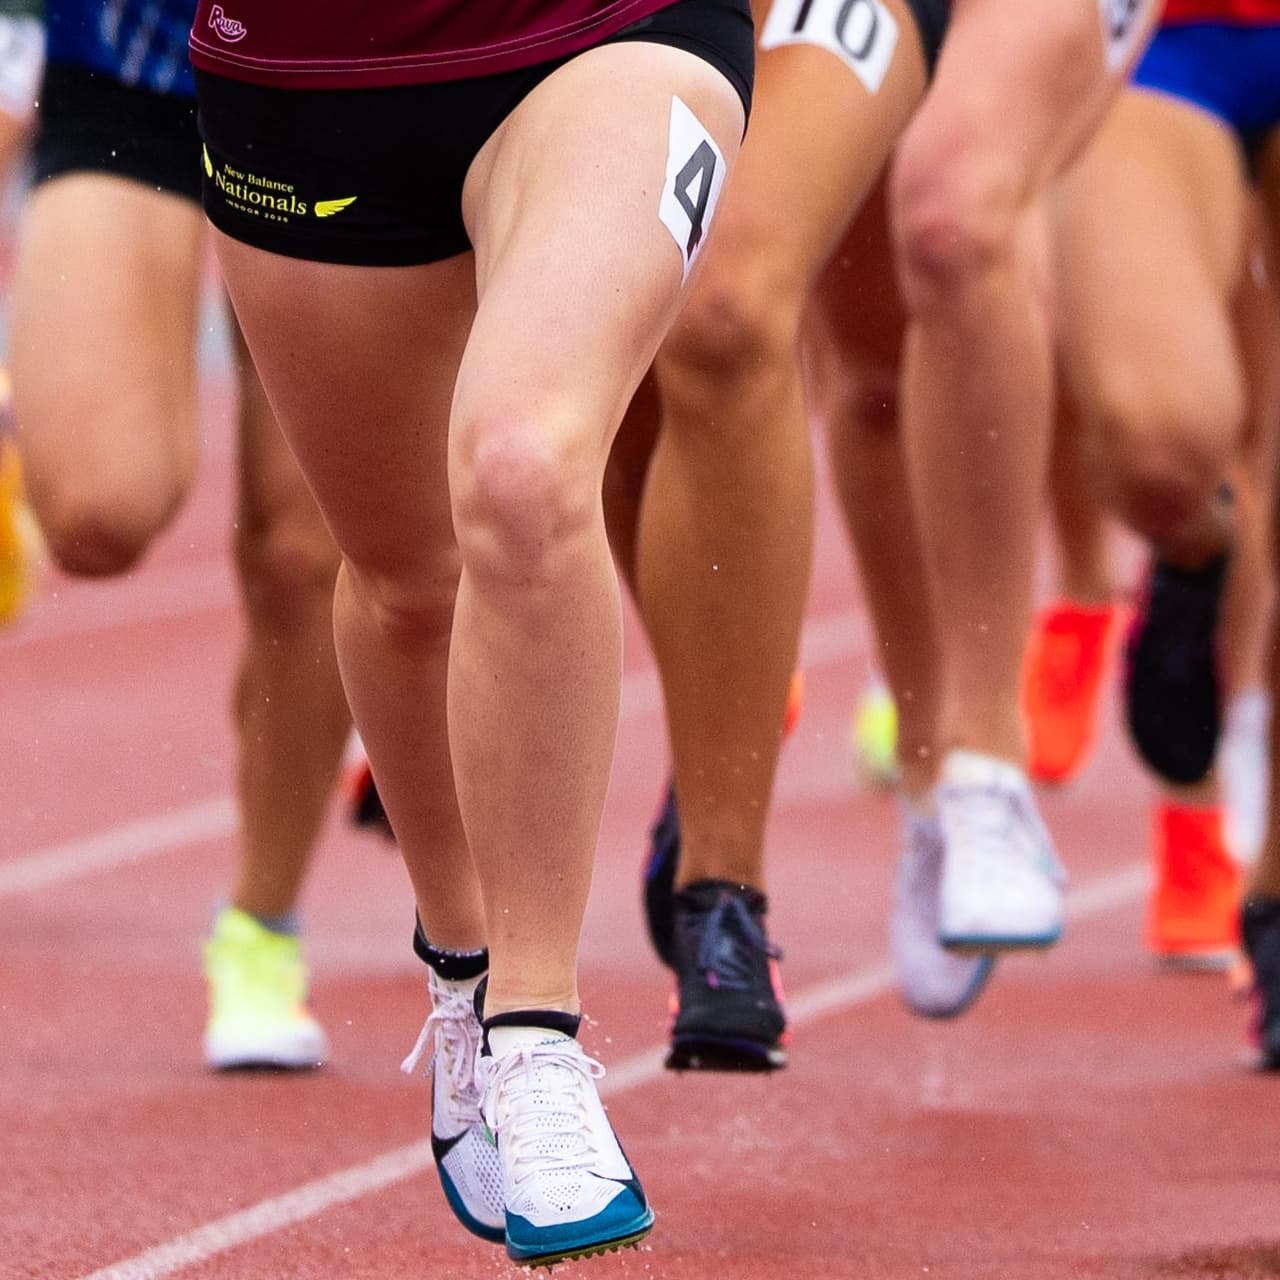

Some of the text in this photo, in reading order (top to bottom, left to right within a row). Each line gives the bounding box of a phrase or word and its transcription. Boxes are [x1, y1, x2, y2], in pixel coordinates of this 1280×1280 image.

[215, 170, 308, 216] Nationals
[224, 163, 295, 194] New Balance
[673, 138, 718, 262] 4
